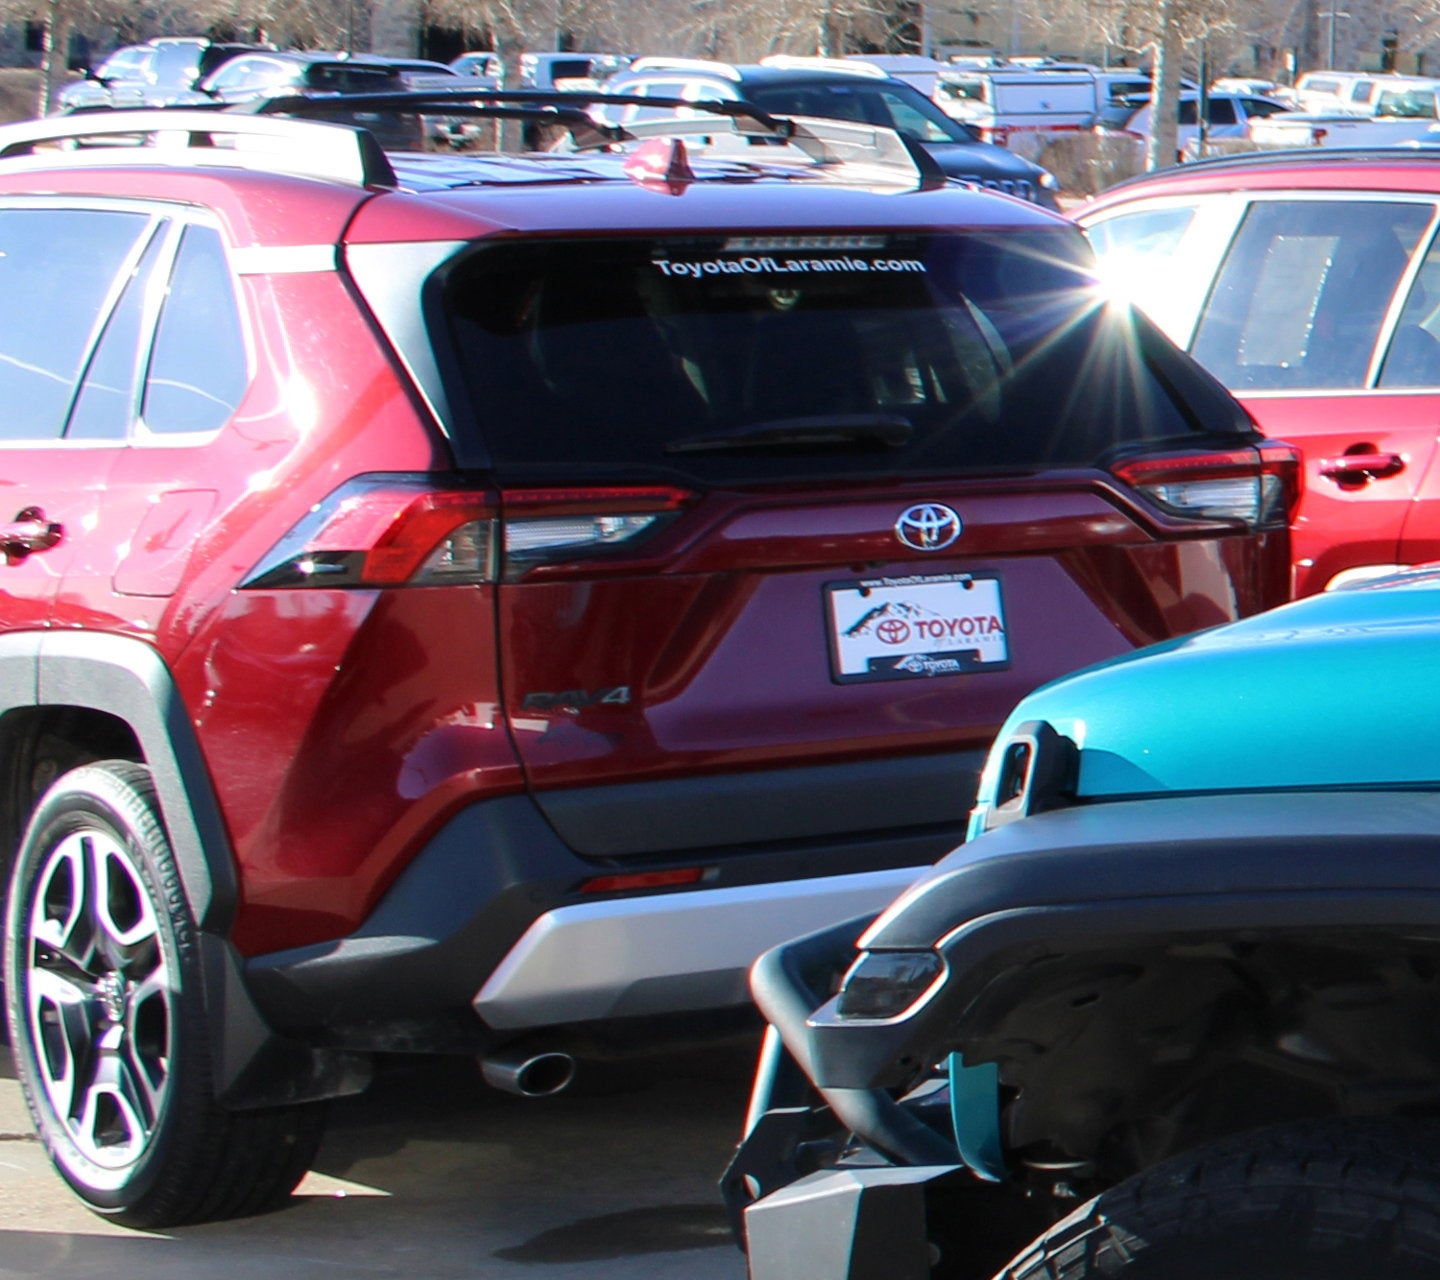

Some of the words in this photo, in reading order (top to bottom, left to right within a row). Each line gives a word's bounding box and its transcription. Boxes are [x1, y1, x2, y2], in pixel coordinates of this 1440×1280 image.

[652, 256, 927, 278] ToyotaOfLaramie.com
[915, 616, 1004, 639] TOYOTA
[923, 659, 960, 670] TOYOTA
[520, 684, 632, 711] RAV4
